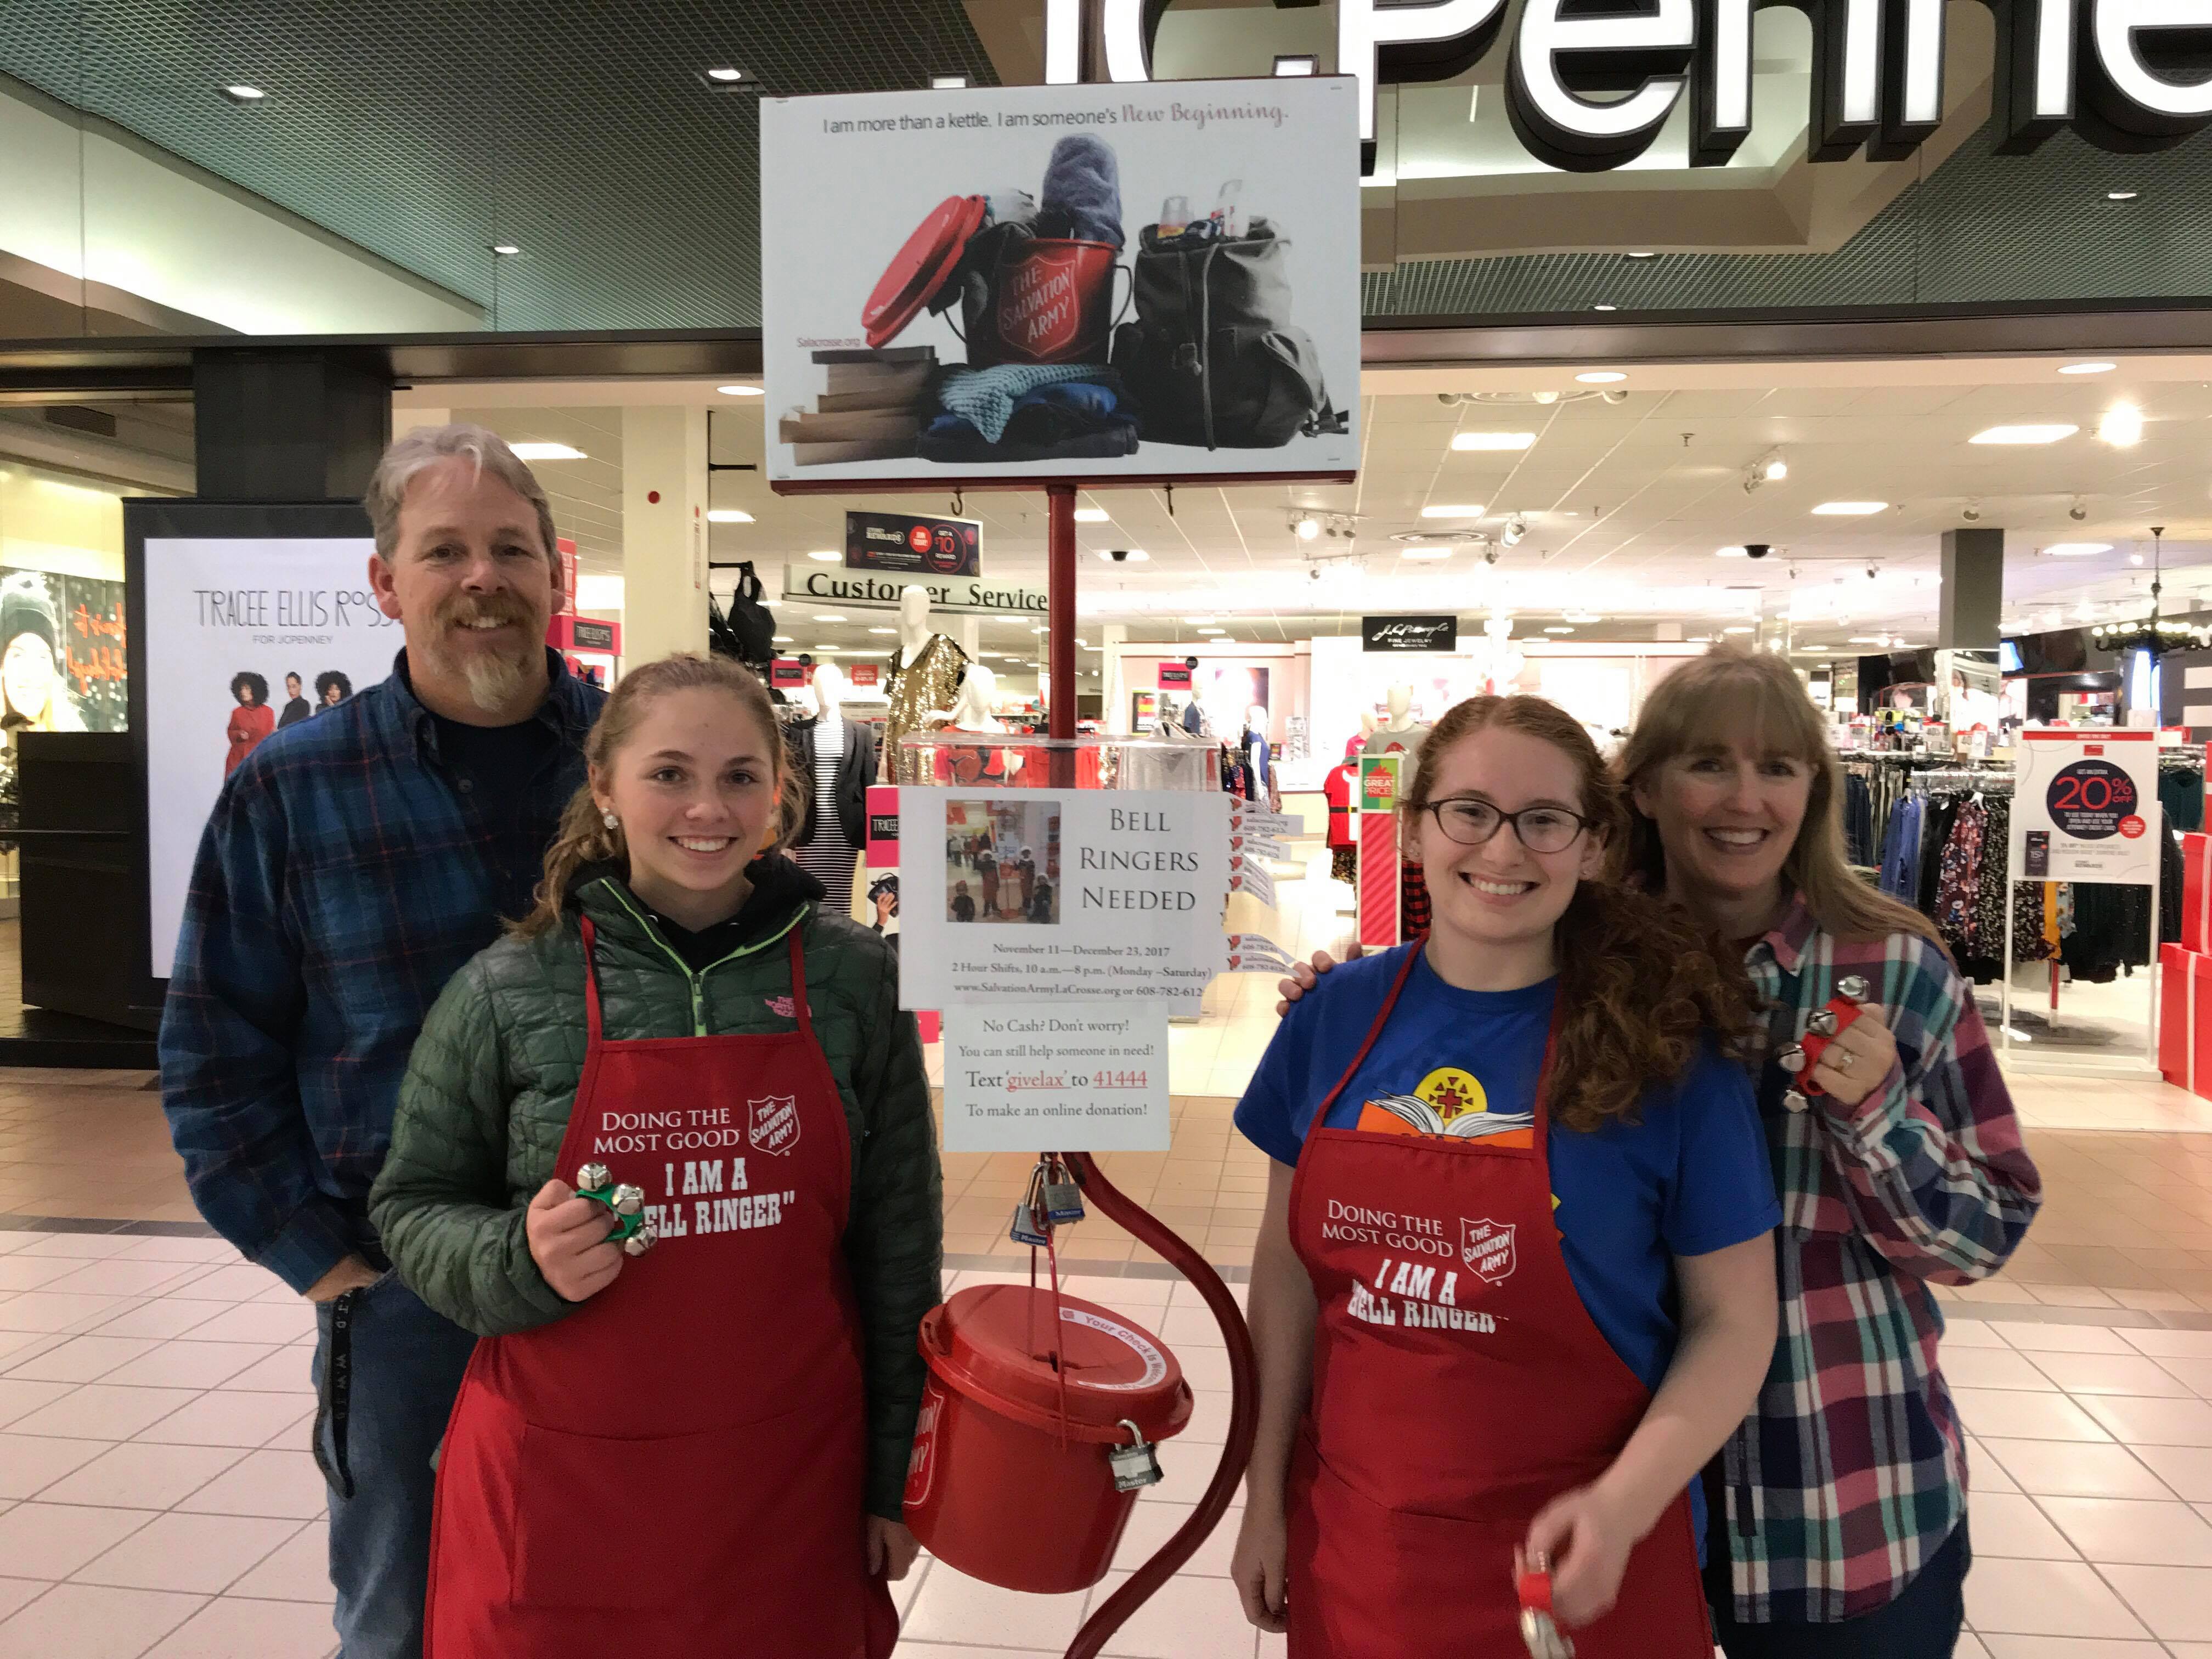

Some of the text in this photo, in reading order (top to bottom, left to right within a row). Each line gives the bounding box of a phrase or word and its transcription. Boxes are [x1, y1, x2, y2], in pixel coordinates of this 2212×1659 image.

[823, 103, 1289, 133] I am more than a kettle. I am someone's New Beginning.
[1013, 266, 1043, 296] THE
[1003, 267, 1071, 330] SALVATION
[1028, 296, 1070, 343] ARMY
[808, 573, 1047, 611] Custoer Service
[193, 590, 269, 627] TRACEE
[277, 590, 329, 627] ELLIS
[252, 634, 274, 645] FOR
[1364, 787, 1396, 795] PRICES
[1110, 808, 1171, 832] BELL
[1080, 847, 1199, 872] RINGERS
[1082, 886, 1196, 911] NEEDED
[993, 943, 1045, 954] November
[1126, 946, 1142, 957] 23,
[1145, 947, 1170, 957] 2017
[952, 962, 958, 972] 2
[961, 962, 988, 973] Hour
[990, 962, 1023, 973] Shifts,
[1025, 964, 1038, 973] 10
[1084, 966, 1106, 977] p.m.
[1107, 965, 1153, 979] (Monday
[953, 982, 1121, 998] www.SalvationArmyLaCrosse.org
[1136, 986, 1204, 997] 608-782-612
[983, 1019, 1129, 1035] No Cash? Don't worry!
[958, 1045, 1154, 1059] You can still help someone in need!
[965, 1070, 1003, 1087] Text
[1071, 1075, 1088, 1087] to
[1092, 1070, 1148, 1089] 41444
[602, 1108, 731, 1132] DOING THE
[755, 1101, 776, 1122] THE
[966, 1103, 1147, 1116] To make an online donation!
[750, 1101, 793, 1144] SALVATION
[768, 1119, 793, 1149] ARMY
[594, 1128, 740, 1154] MOST GOOD
[664, 1157, 748, 1197] I AM A
[644, 1203, 688, 1238] ELL
[1328, 1199, 1443, 1237] DOING THE
[1321, 1221, 1454, 1258] MOST GOOD
[1469, 1224, 1492, 1243] THE
[1464, 1231, 1510, 1262] SALVATION
[1480, 1249, 1509, 1273] ARMY
[1374, 1258, 1458, 1306] I AM A
[1085, 1315, 1116, 1332] Your
[1118, 1329, 1152, 1354] Check
[1147, 1353, 1157, 1362] Is
